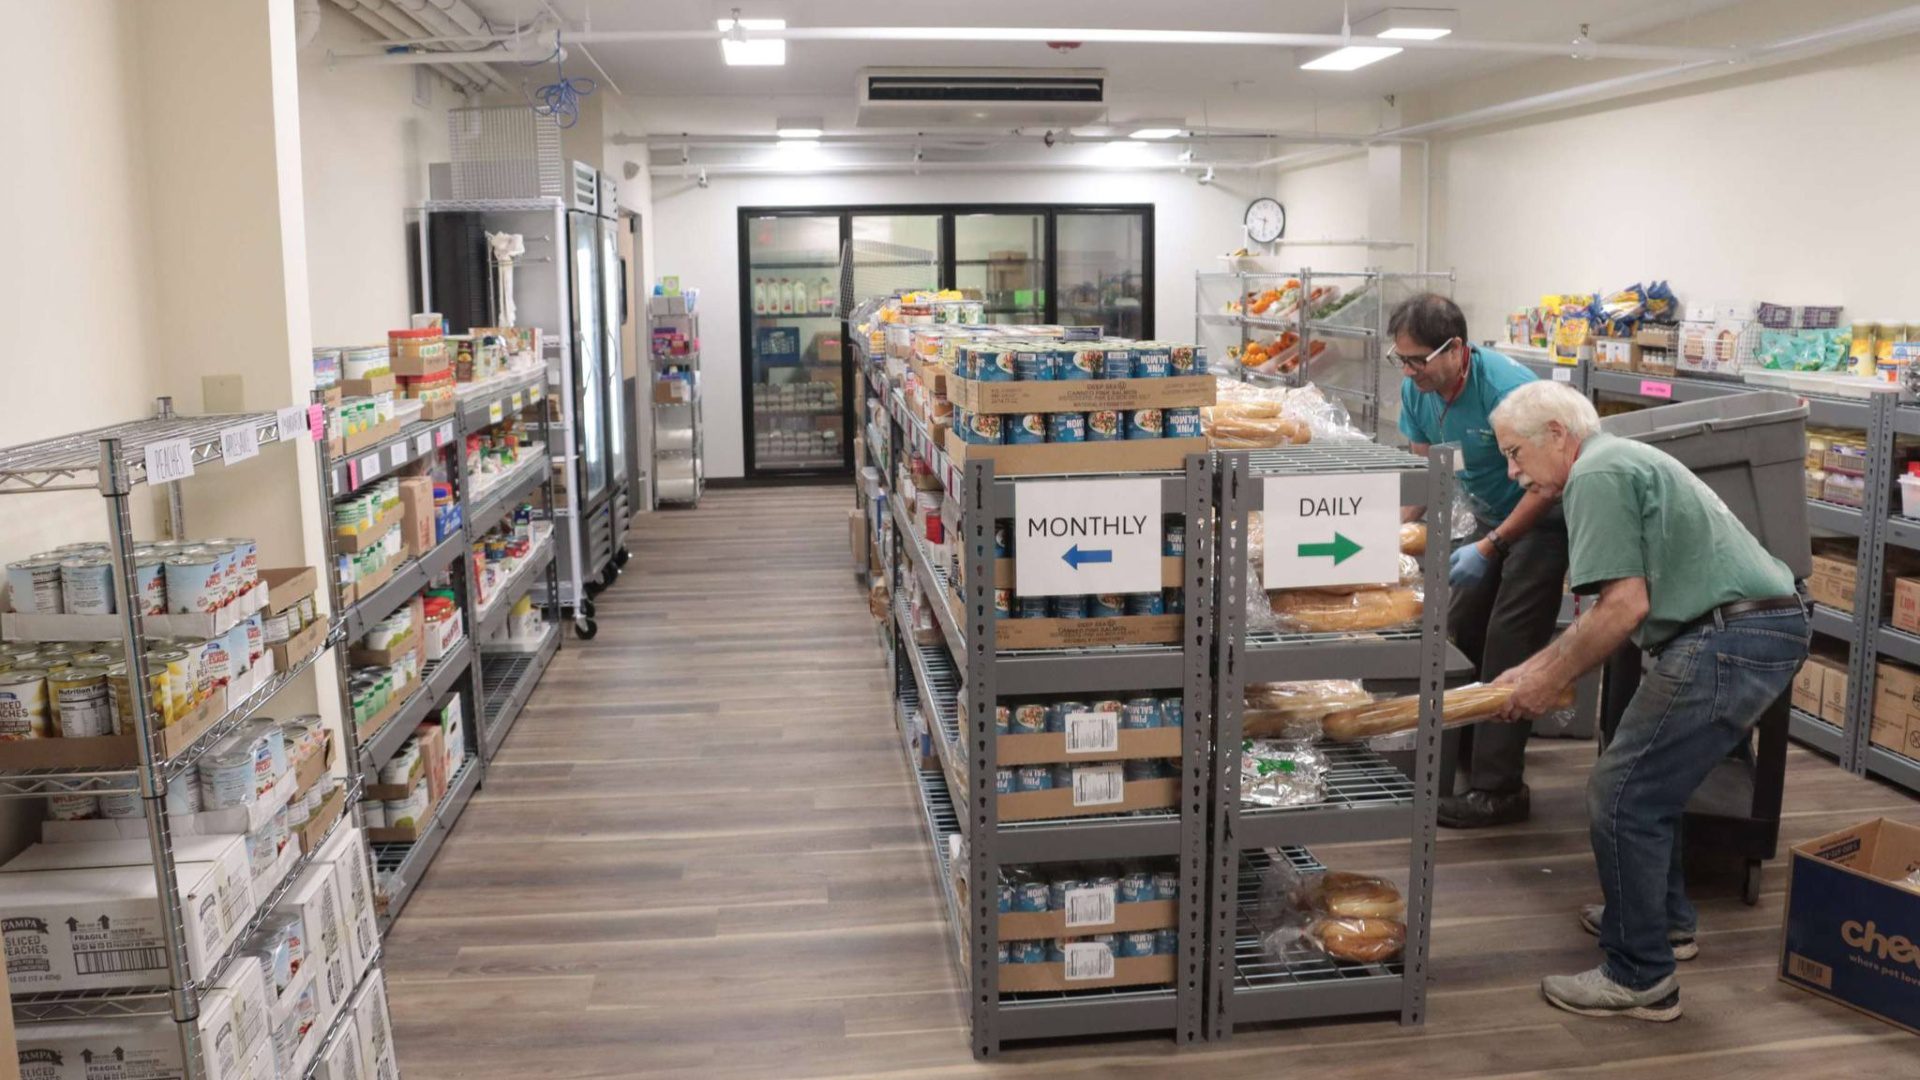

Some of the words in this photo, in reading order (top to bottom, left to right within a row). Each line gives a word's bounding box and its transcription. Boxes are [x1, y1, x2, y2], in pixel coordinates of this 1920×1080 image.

[1141, 354, 1169, 364] SALMON
[1147, 364, 1165, 373] PINK
[1169, 415, 1199, 424] SALMON
[1176, 424, 1194, 433] PINK
[1300, 497, 1362, 517] DAILY
[1028, 515, 1147, 537] MONTHLY
[0, 701, 21, 710] ICED
[2, 919, 38, 930] PAMPA
[5, 935, 41, 947] SLICED
[74, 933, 108, 941] FRAGILE
[1849, 954, 1880, 971] where
[1881, 966, 1899, 978] pet
[19, 1050, 53, 1062] AMPA
